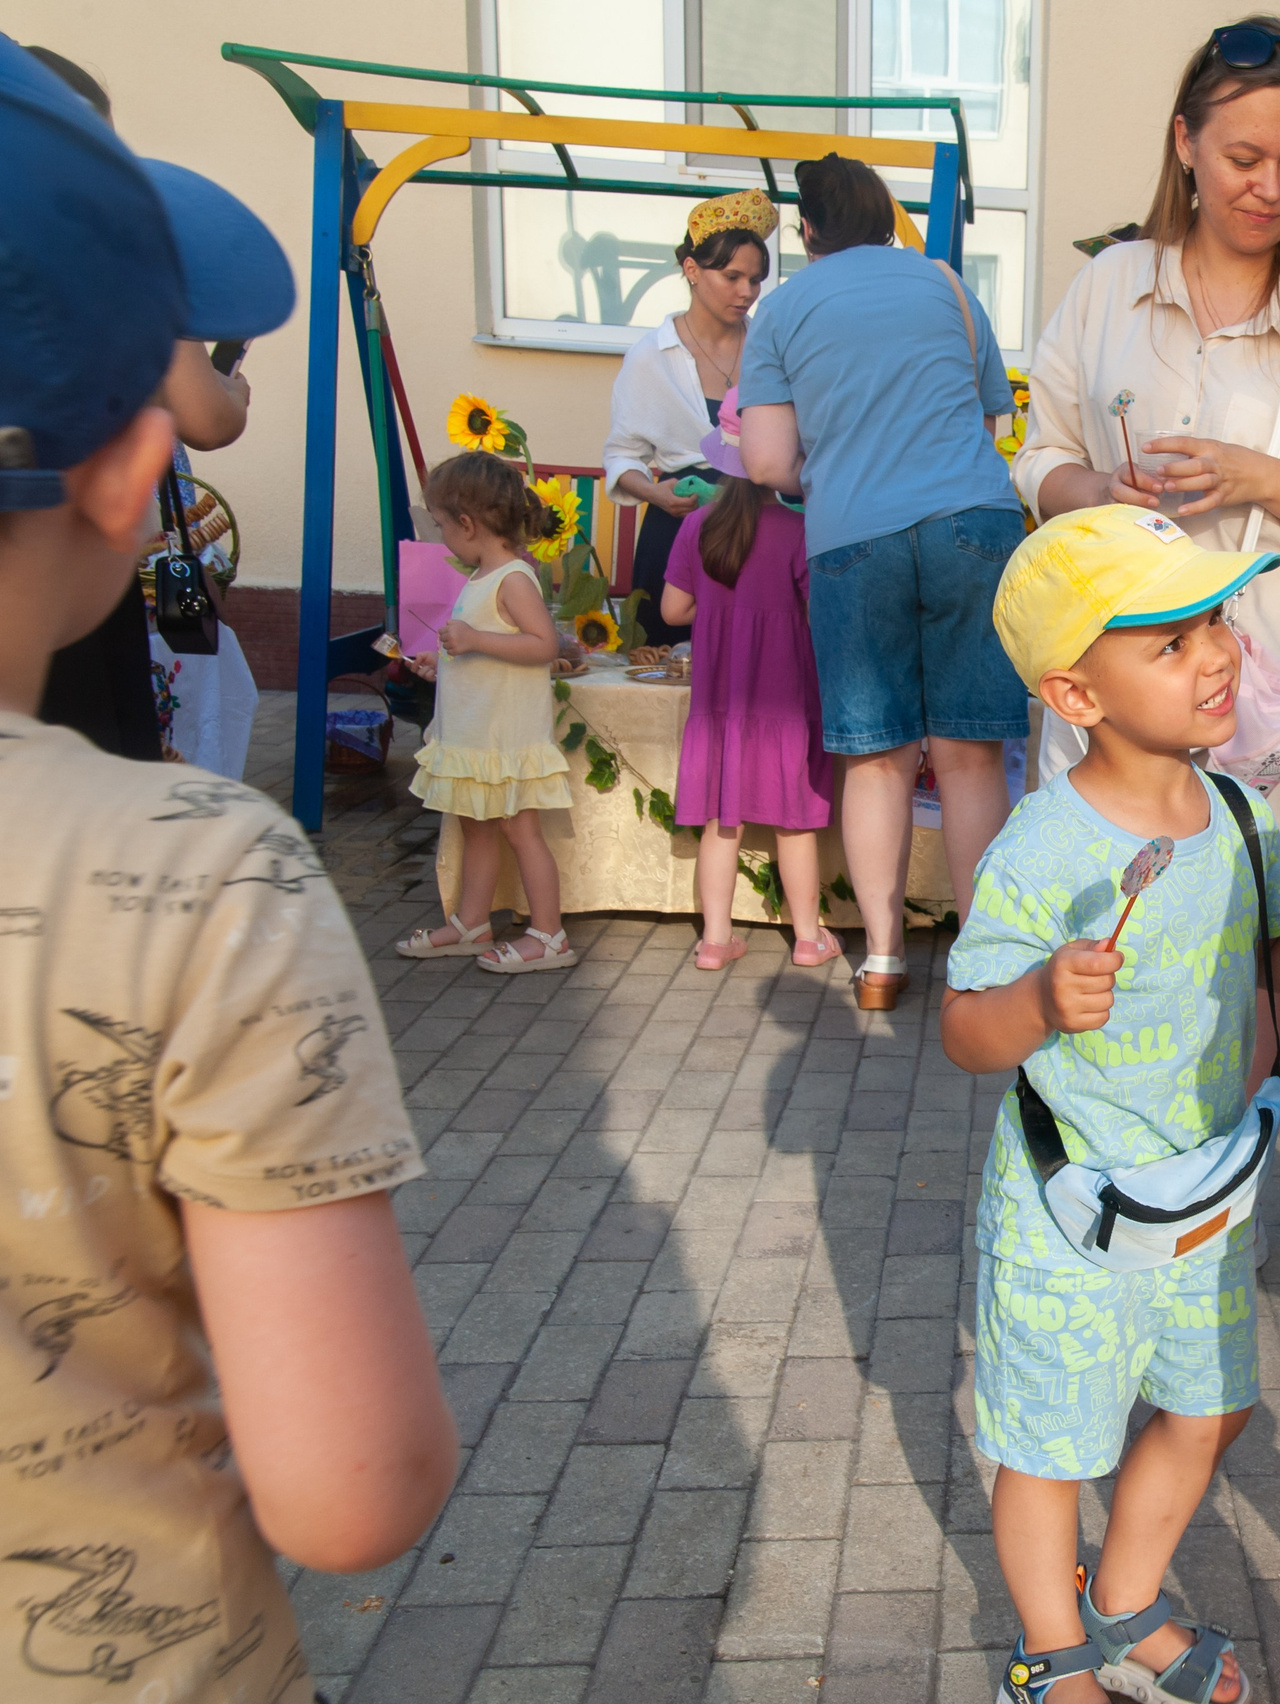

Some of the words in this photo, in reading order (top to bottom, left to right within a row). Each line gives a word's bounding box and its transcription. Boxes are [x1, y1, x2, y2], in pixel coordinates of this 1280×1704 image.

[1015, 849, 1076, 887] COOL
[974, 871, 1055, 941] hill
[1140, 888, 1163, 968] READY
[1133, 966, 1187, 994] COOL
[1178, 985, 1201, 1056] READY
[1073, 1022, 1179, 1068] Chill
[1044, 1275, 1082, 1294] OK!
[1164, 1285, 1250, 1330] hill
[1084, 1364, 1114, 1411] FUN!
[1169, 1359, 1248, 1404] GO!
[1025, 1405, 1084, 1438] FUN!
[1029, 1662, 1045, 1675] 985
